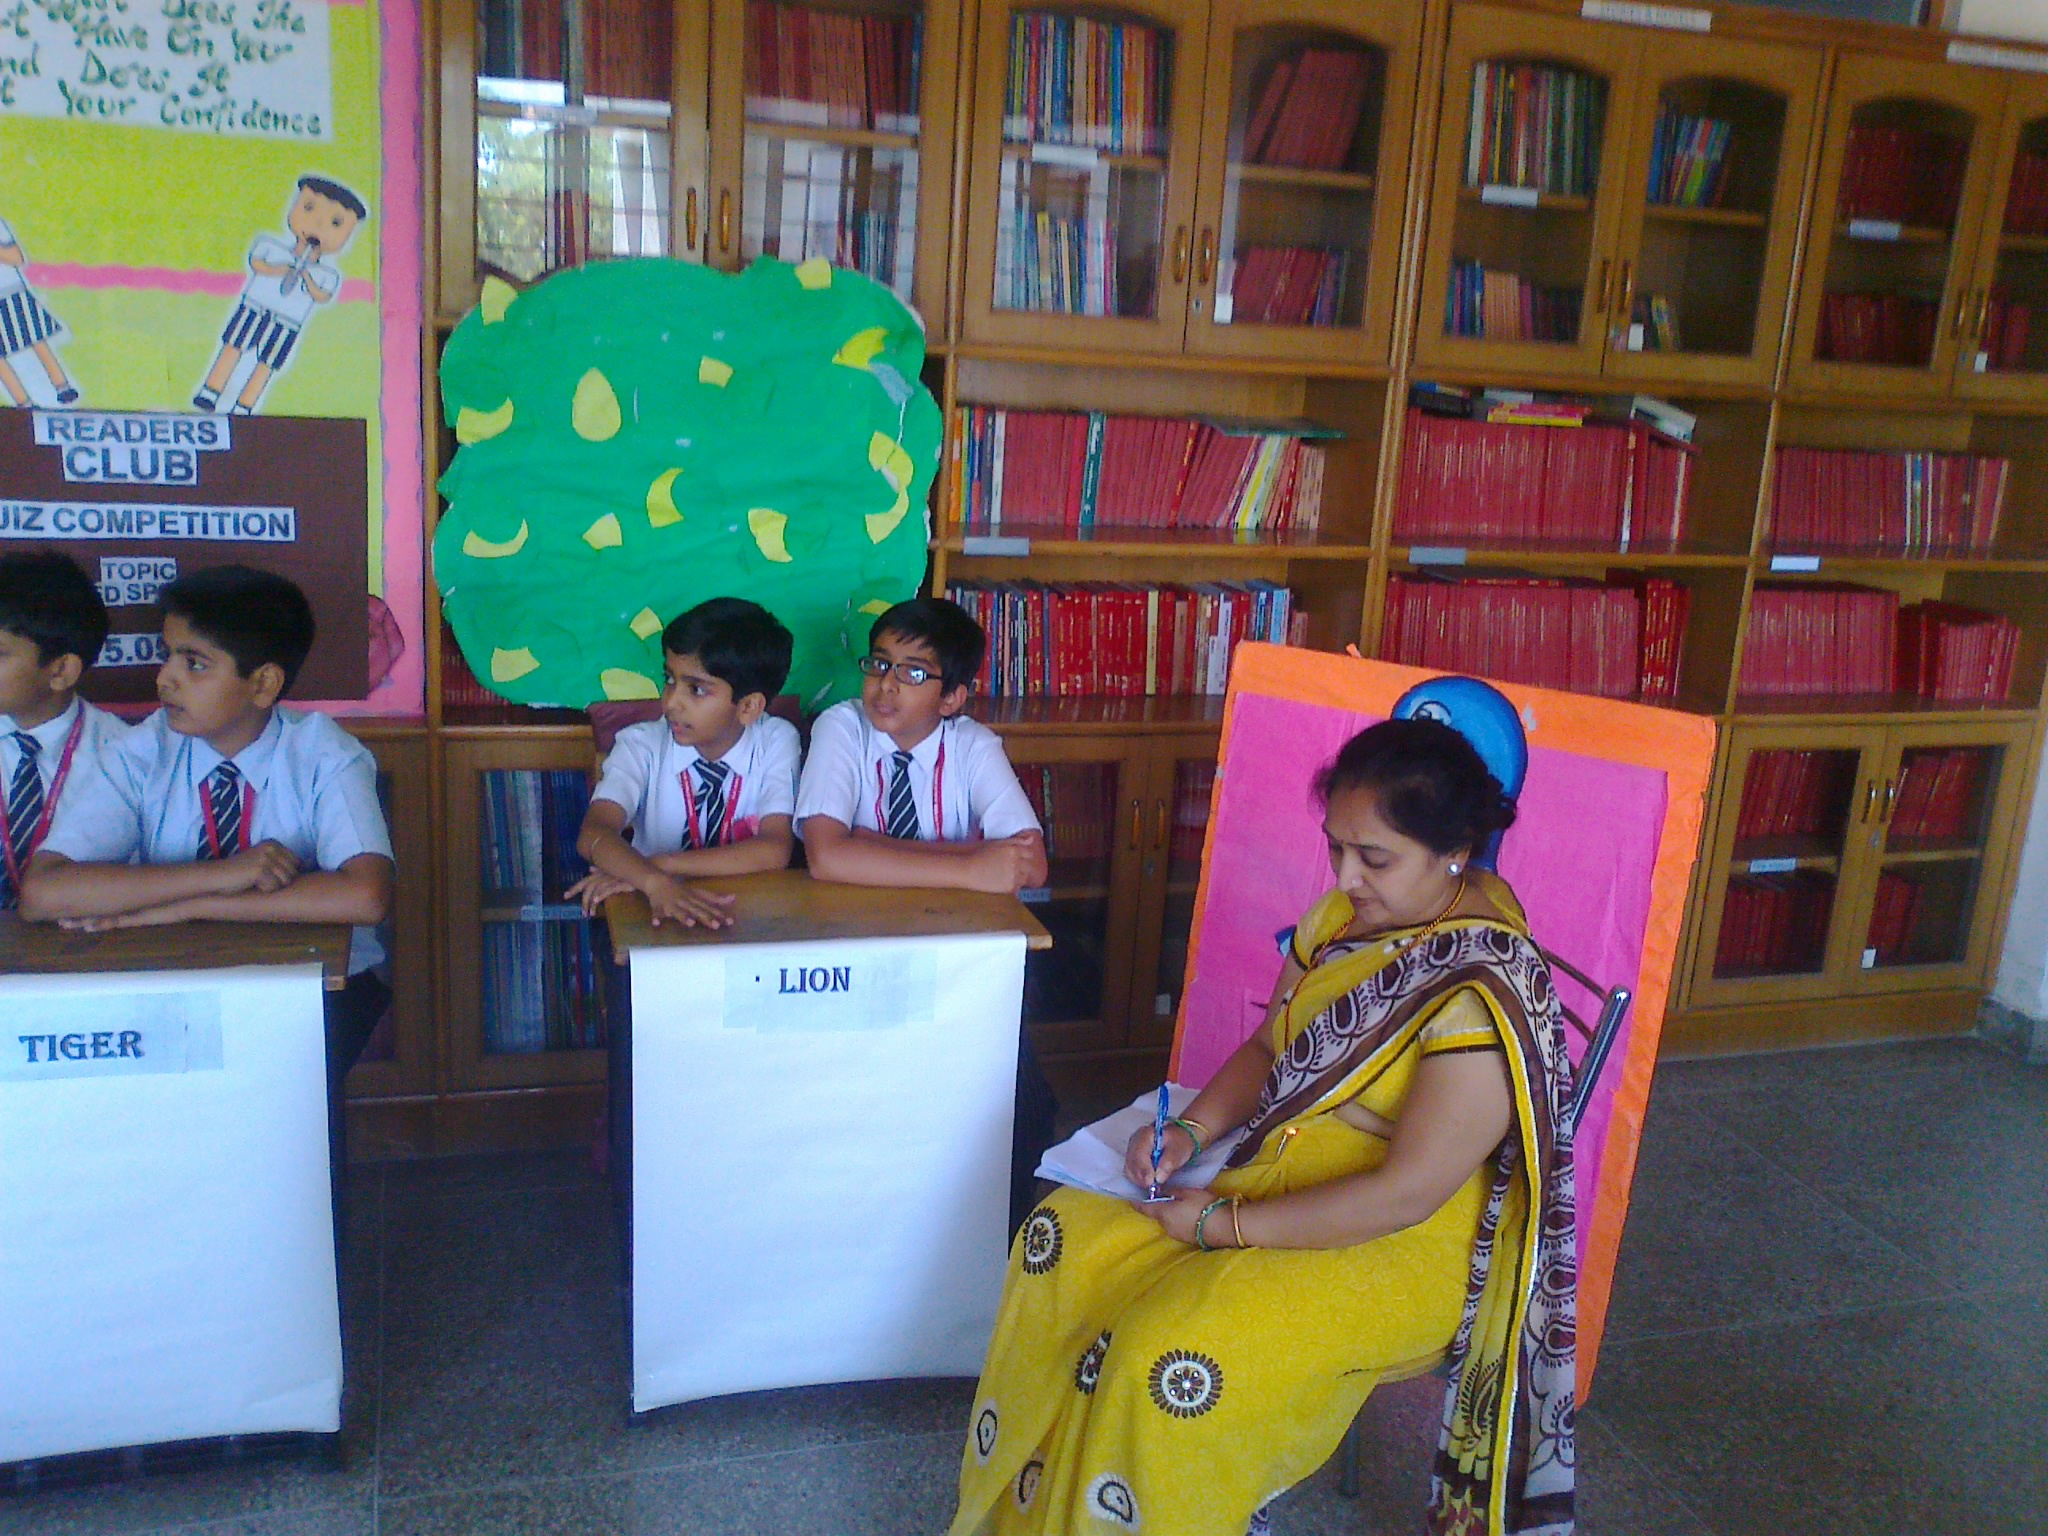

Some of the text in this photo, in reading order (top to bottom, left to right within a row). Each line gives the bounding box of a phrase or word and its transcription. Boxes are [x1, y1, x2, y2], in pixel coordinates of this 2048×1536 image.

[80, 48, 170, 93] Does
[57, 79, 137, 116] Your
[160, 94, 322, 135] Confidence
[47, 417, 218, 445] READERS
[66, 447, 194, 481] CLUB
[53, 508, 291, 538] COMPETITION
[102, 562, 177, 580] TOPIC
[127, 583, 160, 600] SP
[779, 966, 851, 994] LION
[18, 1030, 145, 1063] TIGER
